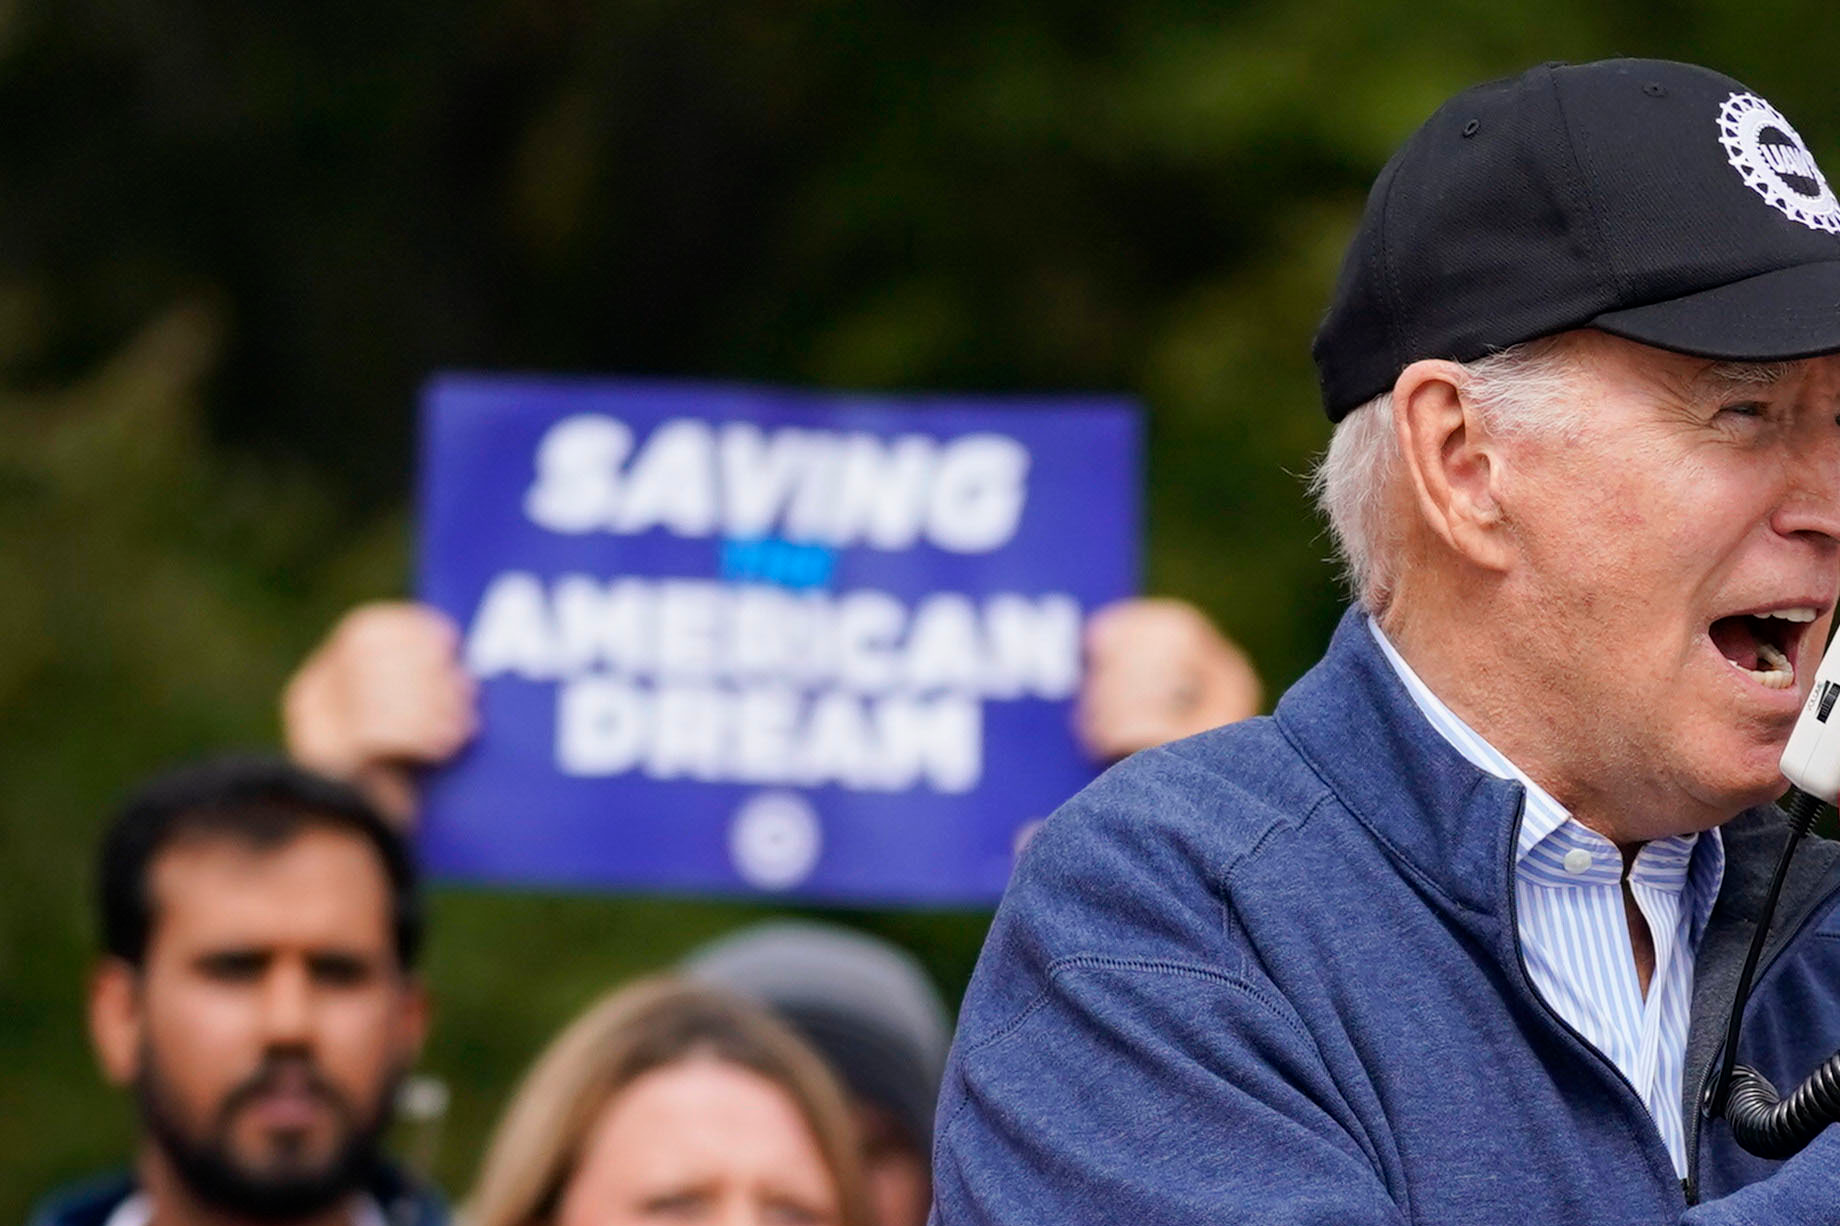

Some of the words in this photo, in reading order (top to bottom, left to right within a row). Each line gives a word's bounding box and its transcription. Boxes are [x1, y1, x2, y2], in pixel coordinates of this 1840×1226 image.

[525, 414, 1031, 554] SAVING
[467, 573, 1083, 703] AMERICAN
[556, 675, 983, 794] DREAM
